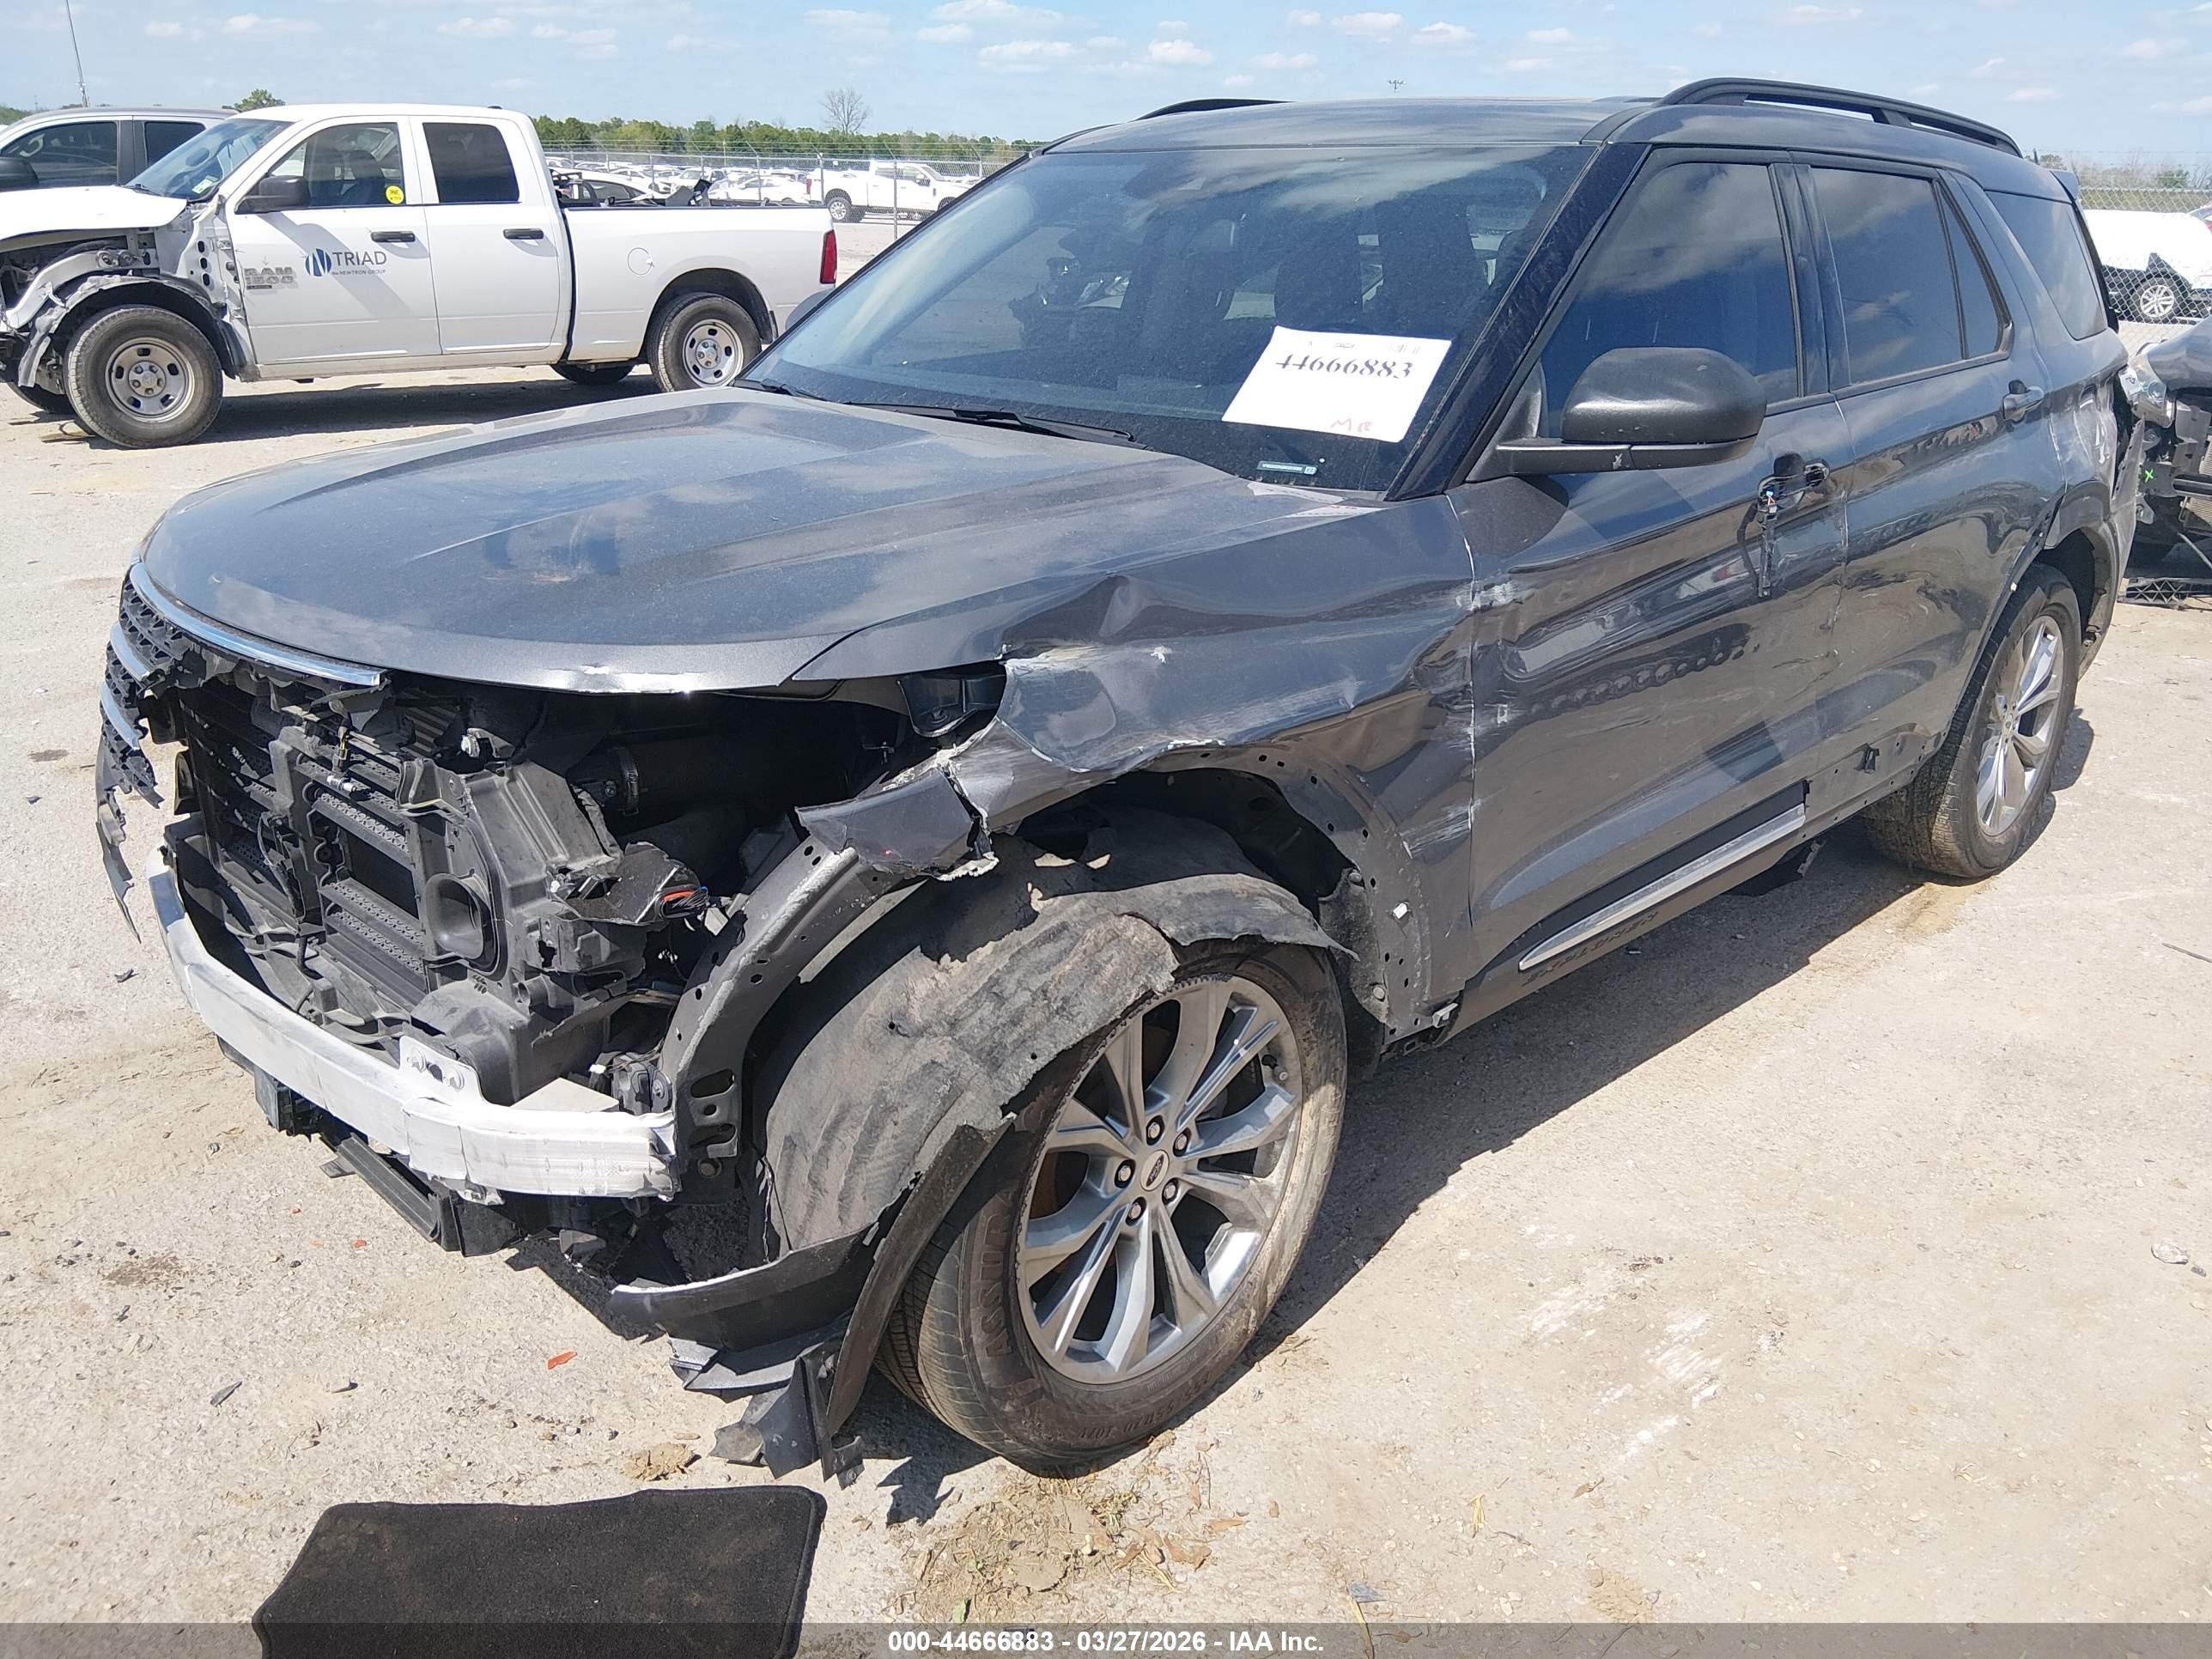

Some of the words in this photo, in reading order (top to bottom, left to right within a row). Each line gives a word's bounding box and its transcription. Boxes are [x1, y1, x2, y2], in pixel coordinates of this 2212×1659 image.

[332, 252, 386, 266] TRIAD
[244, 267, 294, 276] RAM
[245, 276, 294, 285] 1500
[1276, 354, 1413, 379] 44666883
